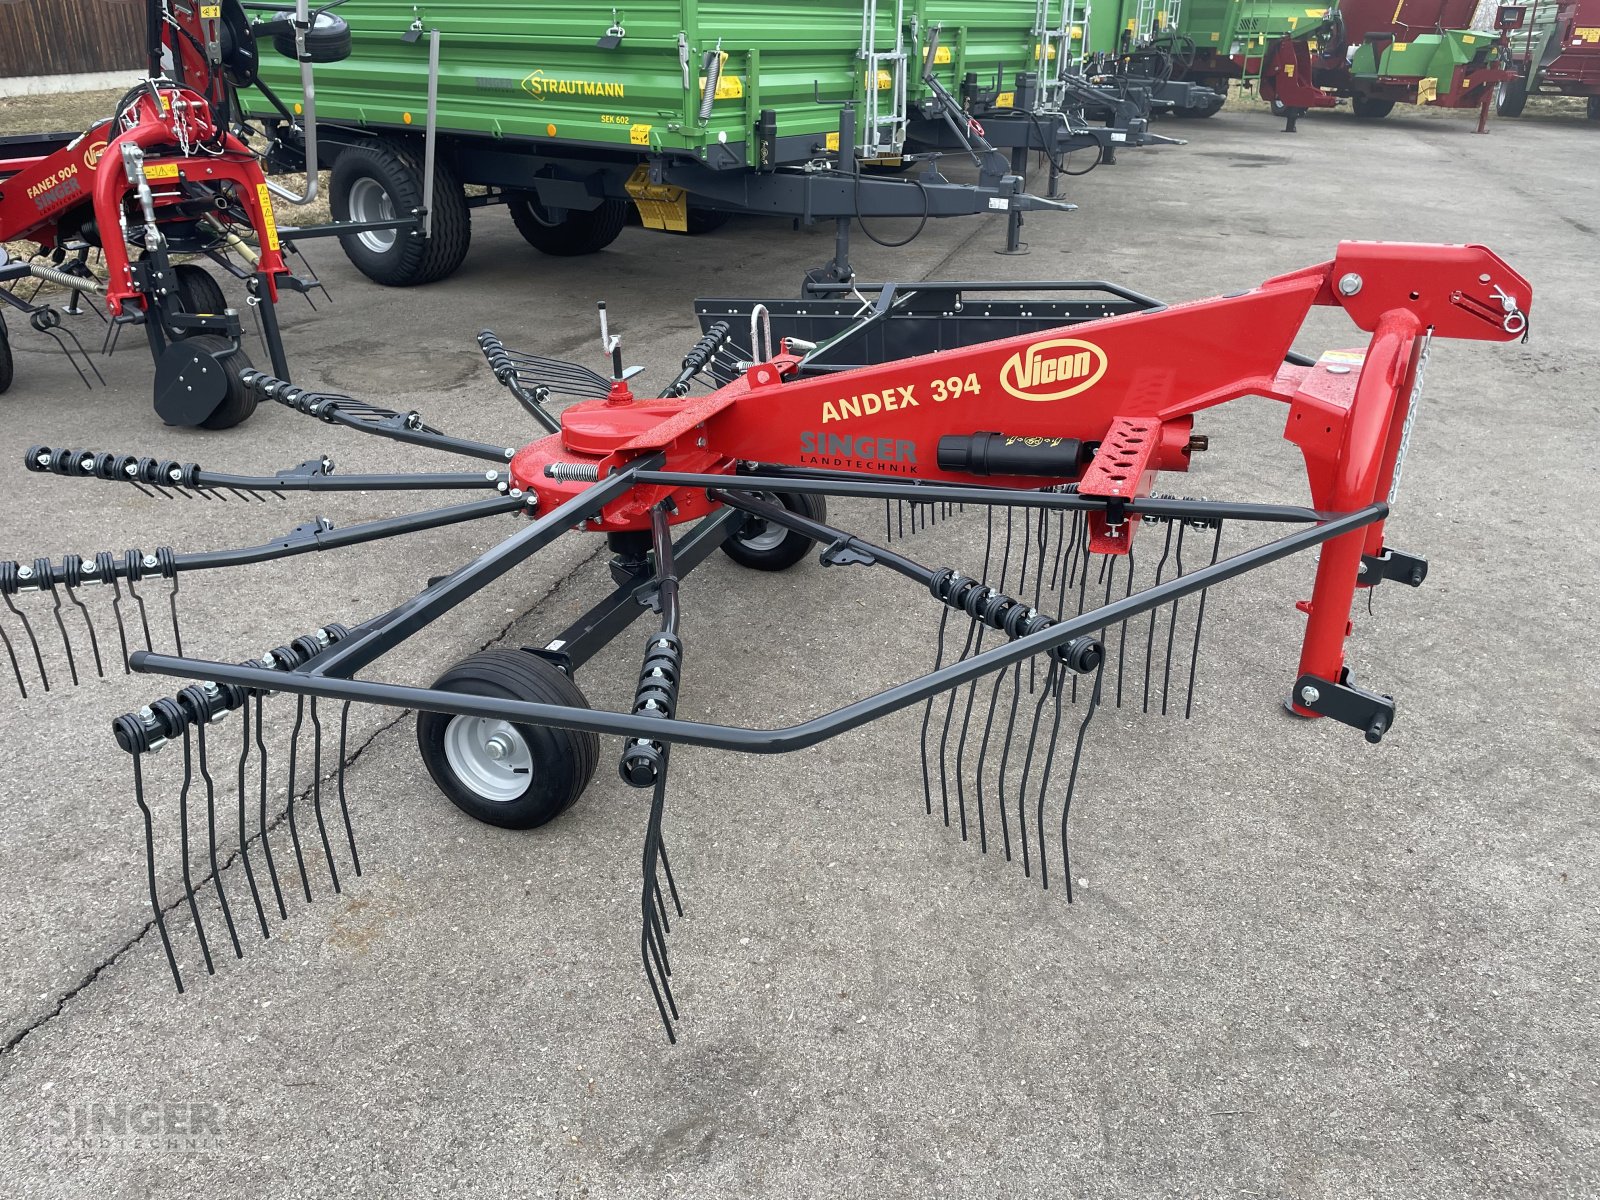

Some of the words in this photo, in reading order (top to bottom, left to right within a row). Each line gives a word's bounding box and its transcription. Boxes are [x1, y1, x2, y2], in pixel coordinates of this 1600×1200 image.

[531, 76, 625, 98] STRAUTMANN
[601, 115, 614, 124] SEK
[615, 116, 630, 125] 602
[26, 174, 59, 199] FANEX
[57, 163, 78, 181] 904
[34, 177, 80, 211] SINGER
[1008, 346, 1092, 389] Vicon
[821, 384, 920, 424] ANDEX
[929, 373, 982, 402] 394
[800, 430, 918, 464] SINGER
[800, 455, 919, 474] LANDTECHNIK
